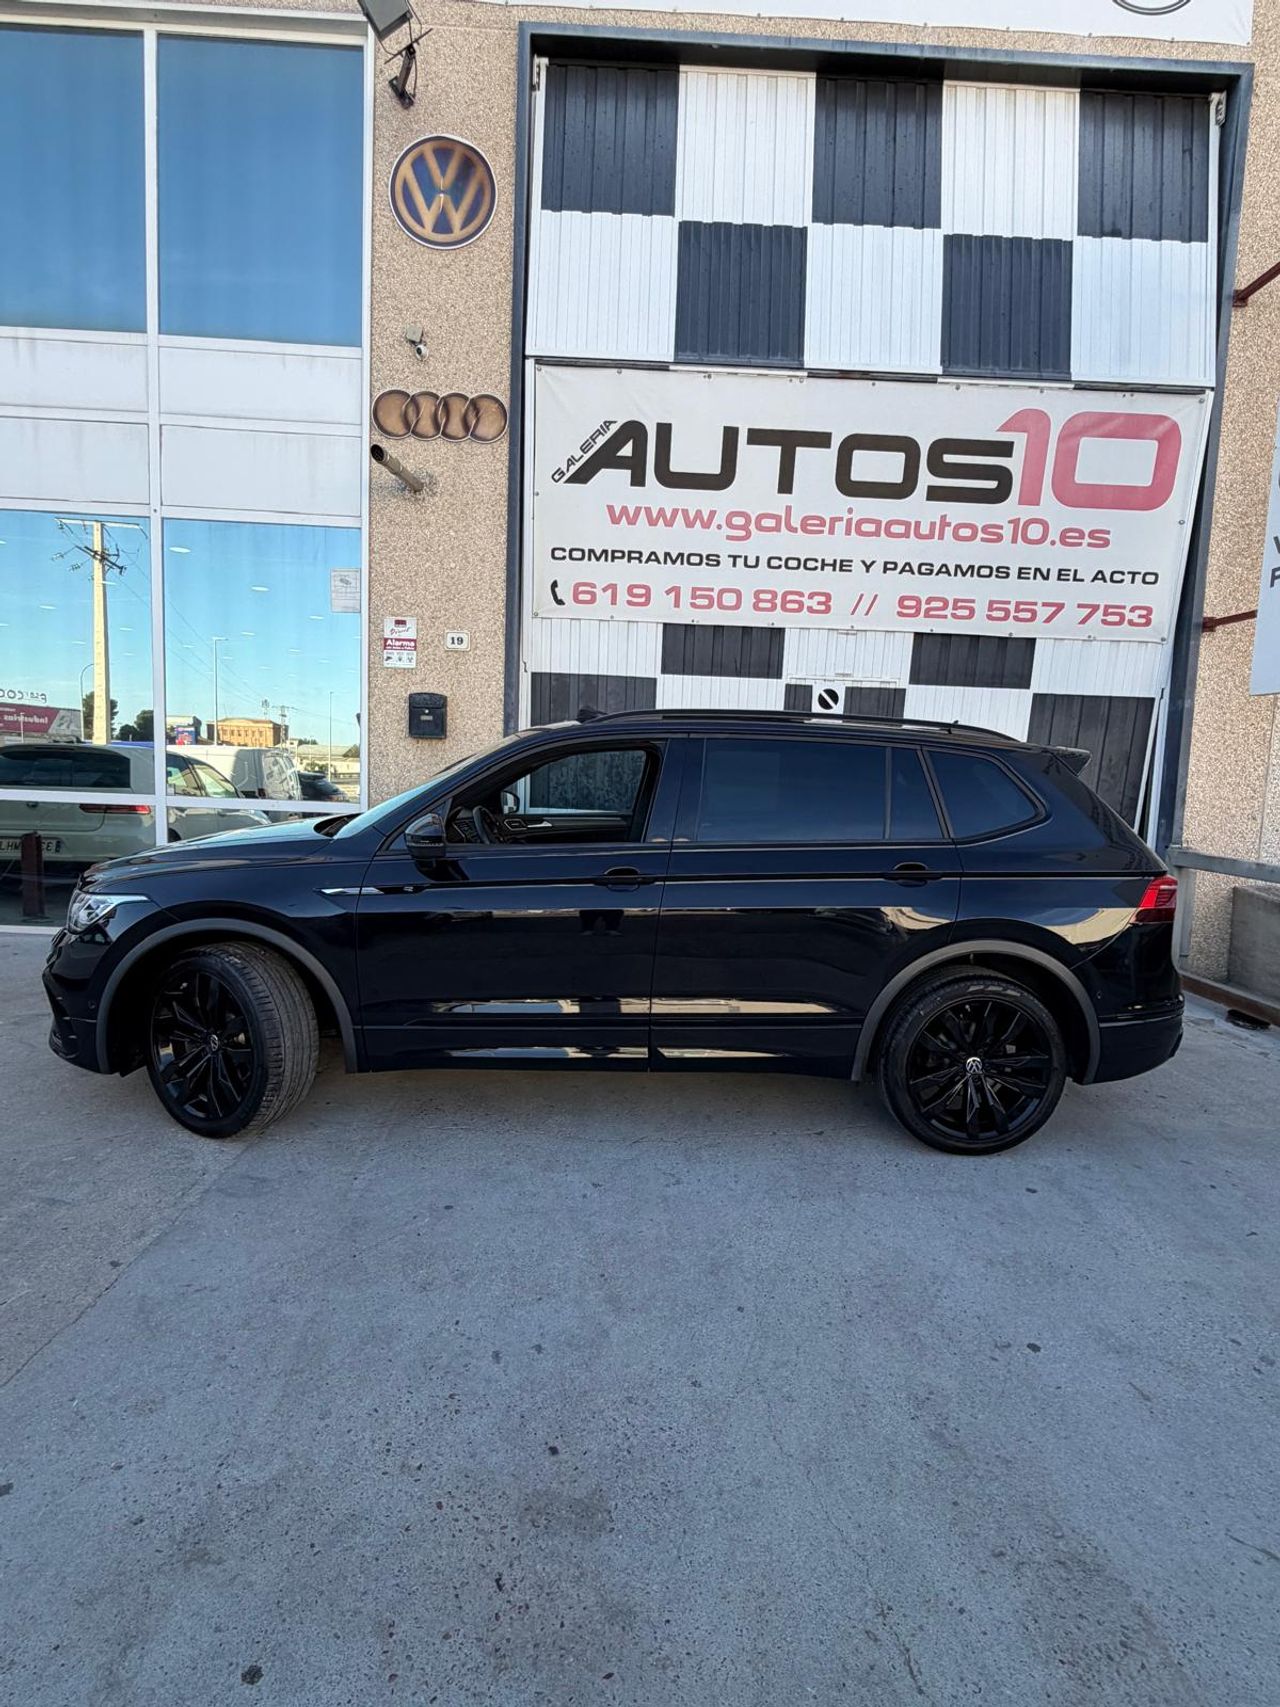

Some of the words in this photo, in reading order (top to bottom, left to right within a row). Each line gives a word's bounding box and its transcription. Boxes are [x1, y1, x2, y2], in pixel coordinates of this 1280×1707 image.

[551, 420, 618, 484] GALERIA
[606, 505, 1111, 549] www.galeriaautos10.es
[550, 547, 721, 567] COMPRAMOS
[728, 554, 760, 570] TU
[766, 556, 853, 573] COCHE
[860, 560, 876, 573] Y
[882, 561, 1011, 580] PAGAMOS
[1016, 566, 1051, 581] EN
[1056, 568, 1085, 583] EL
[1090, 569, 1160, 585] ACTO
[571, 581, 652, 608] 619
[664, 585, 743, 611] 150
[752, 589, 832, 615] 863
[896, 594, 976, 621] 925
[986, 599, 1065, 625] 557
[1076, 603, 1153, 628] 753
[450, 636, 464, 646] 19
